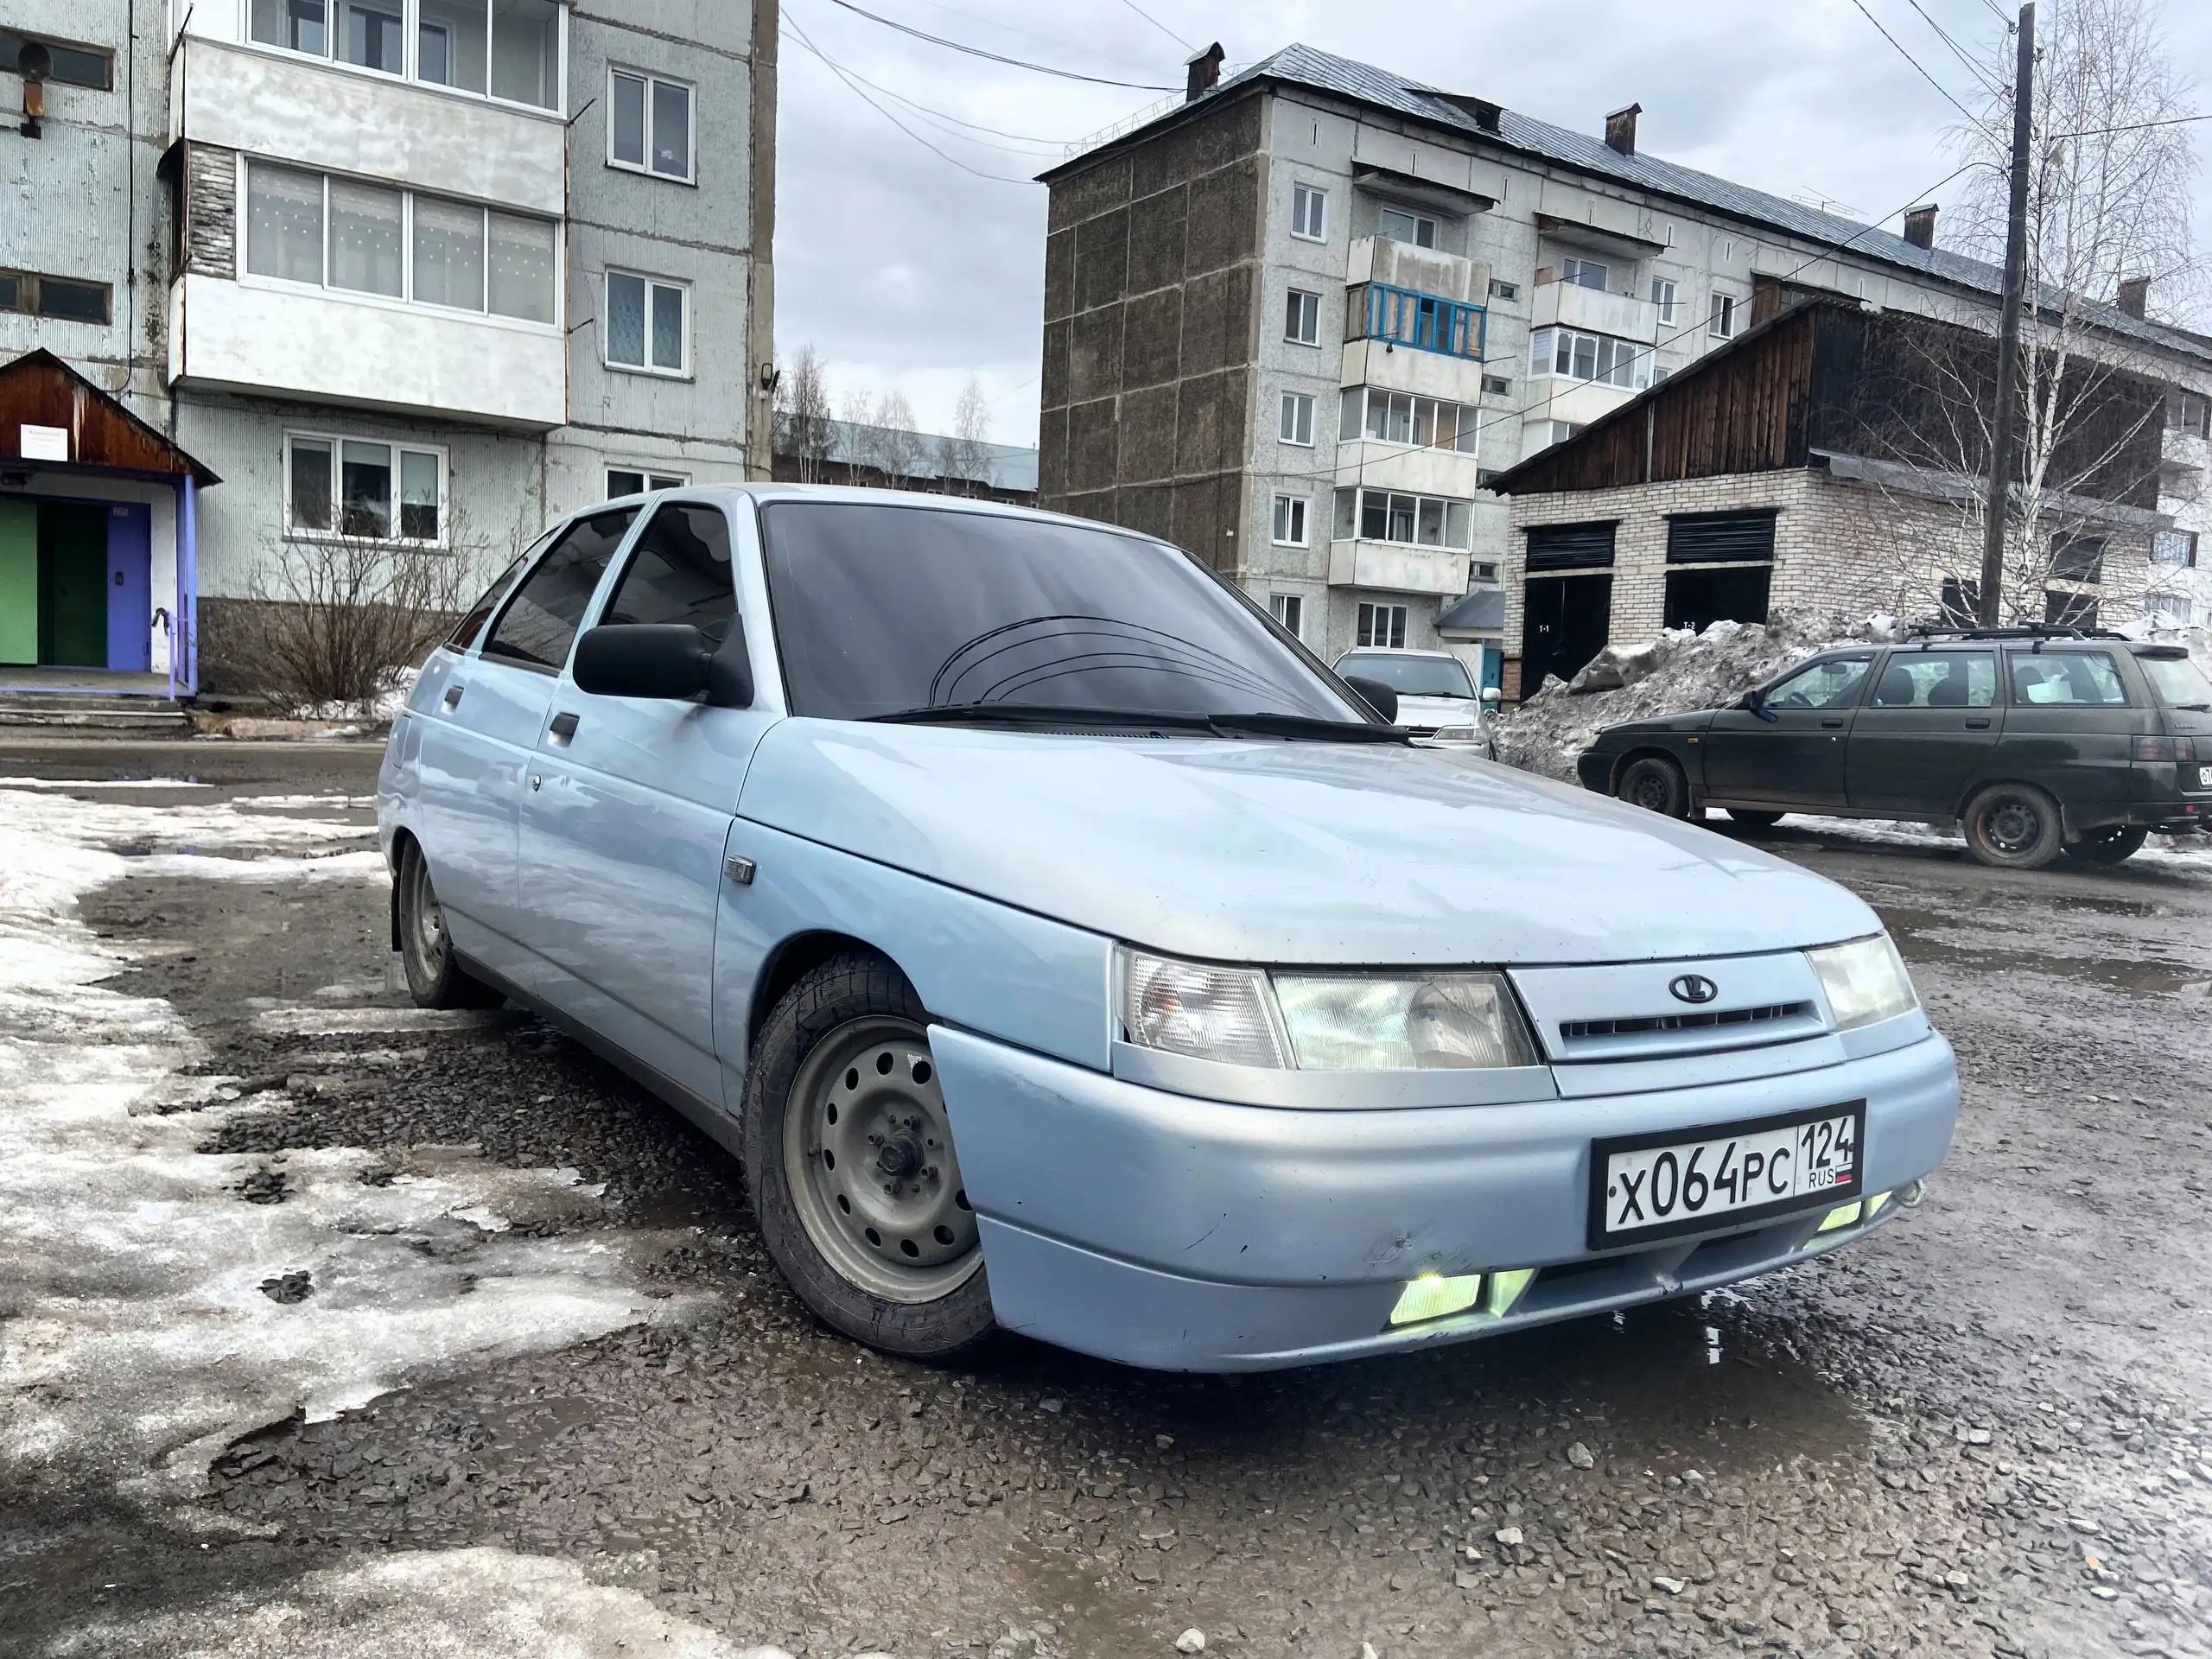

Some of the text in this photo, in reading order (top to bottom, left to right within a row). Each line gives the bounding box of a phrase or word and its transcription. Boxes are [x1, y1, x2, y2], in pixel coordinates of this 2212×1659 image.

[1618, 1118, 1850, 1224] Х064РС 124
[1808, 1167, 1835, 1189] RUS
